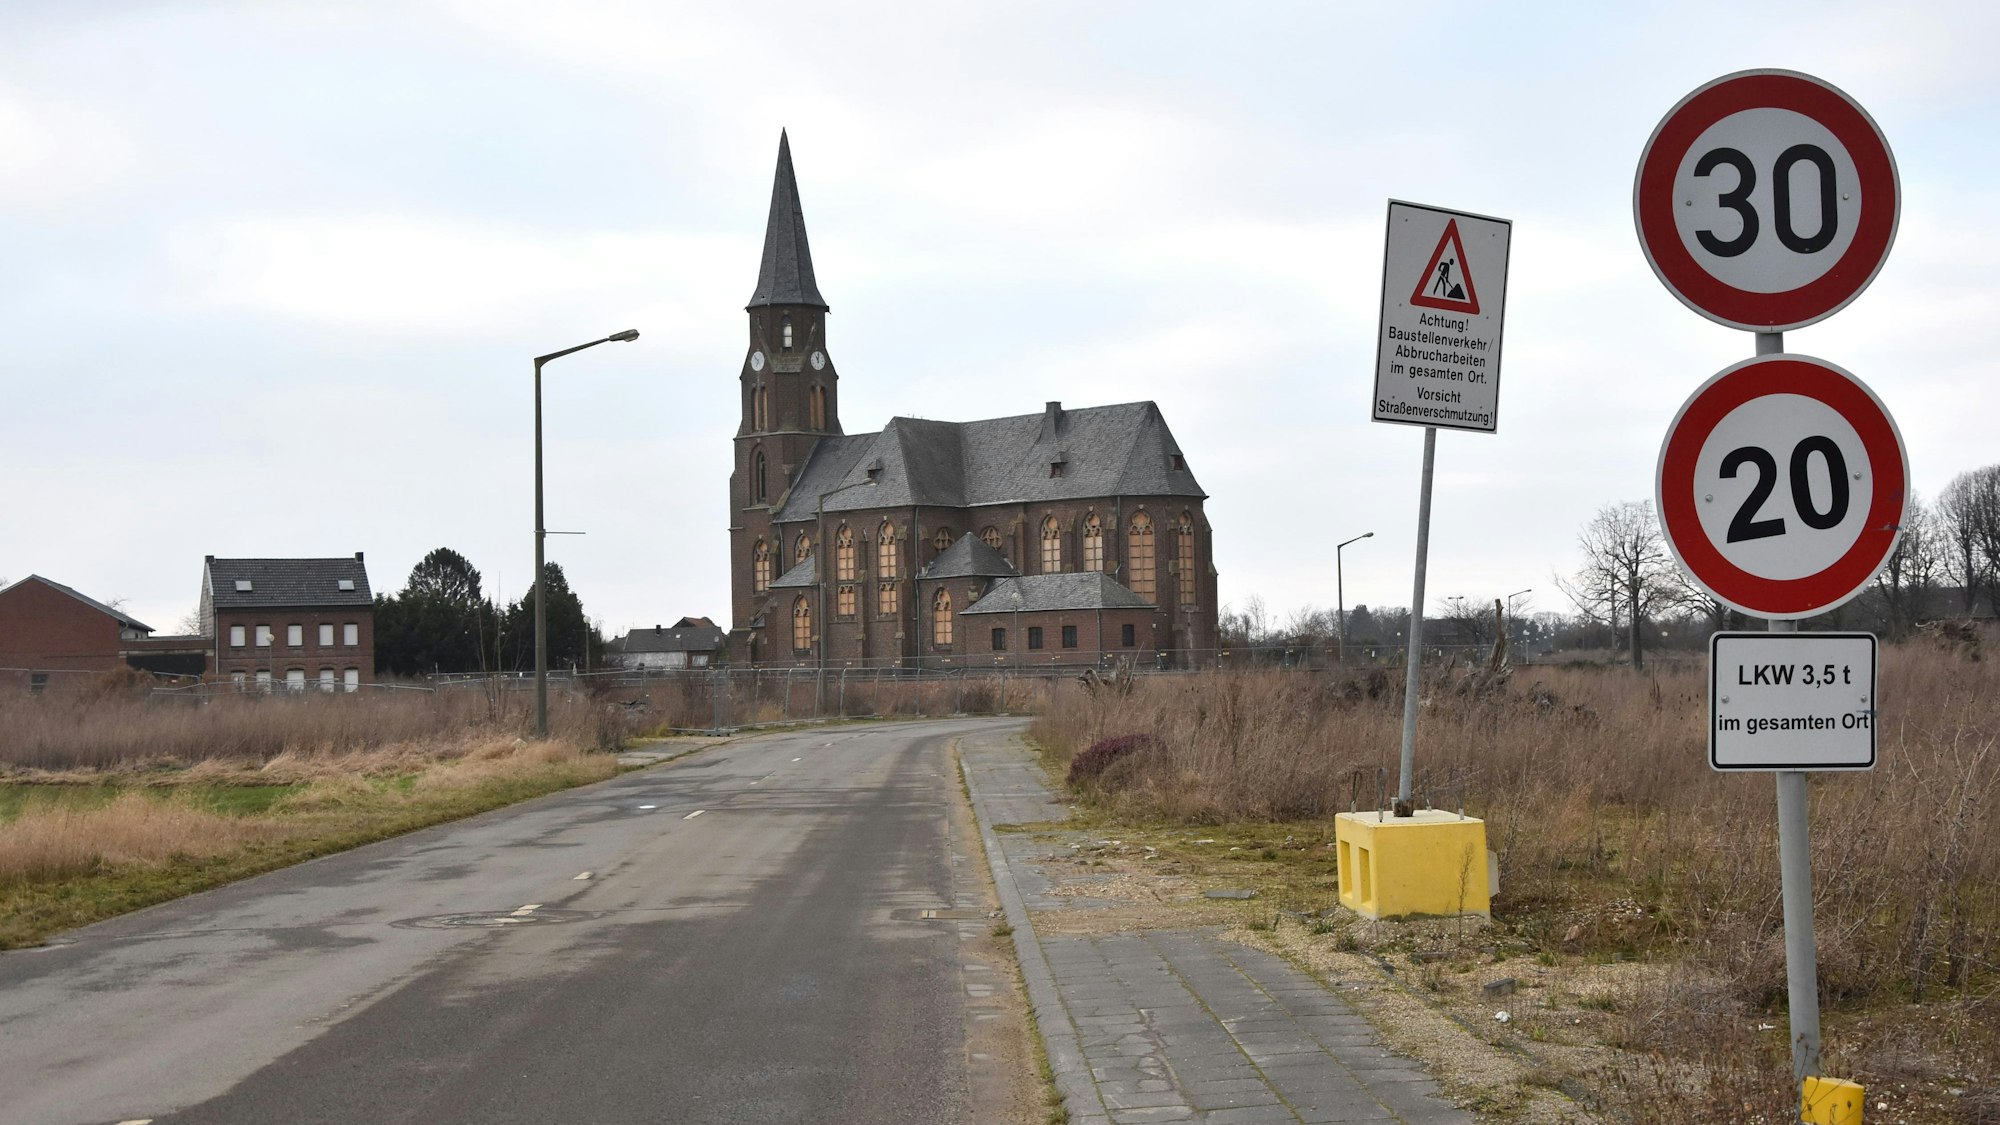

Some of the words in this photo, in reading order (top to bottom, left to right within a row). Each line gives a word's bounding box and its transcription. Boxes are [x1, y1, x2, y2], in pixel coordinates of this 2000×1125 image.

[1693, 144, 1838, 258] 30
[1419, 313, 1469, 332] Achtung!
[1388, 326, 1494, 352] Baustellenverkehr/
[1395, 345, 1486, 367] Abbrucharbeiten
[1390, 361, 1404, 374] im
[1409, 364, 1463, 381] gesamten
[1468, 370, 1487, 384] Ort.
[1417, 386, 1461, 403] Vorsicht
[1378, 399, 1493, 426] Straßenverschmutzung!
[1719, 435, 1849, 544] 20
[1739, 664, 1795, 685] LKW
[1802, 664, 1835, 688] 3,5
[1843, 665, 1851, 685] t
[1719, 715, 1740, 730] im
[1747, 714, 1835, 734] gesamten
[1842, 713, 1869, 729] Ort
